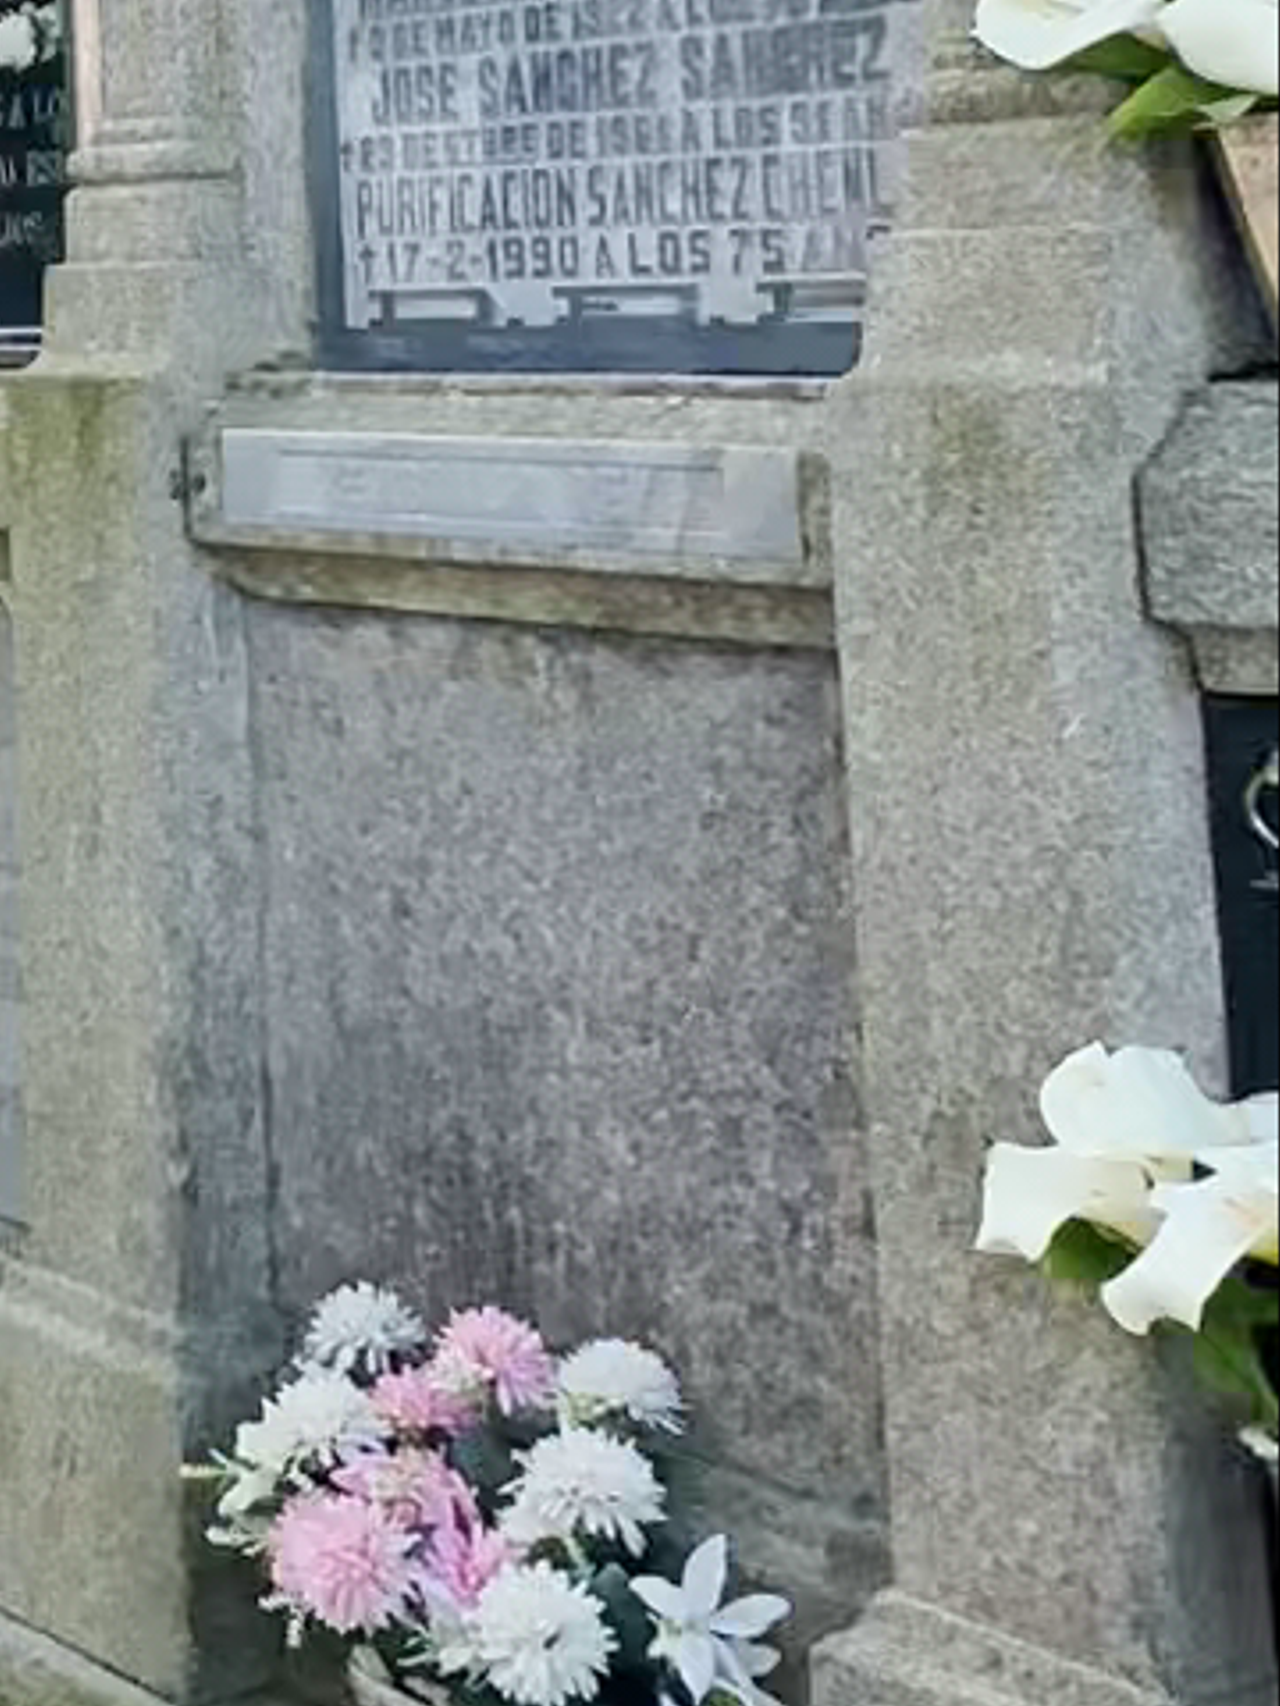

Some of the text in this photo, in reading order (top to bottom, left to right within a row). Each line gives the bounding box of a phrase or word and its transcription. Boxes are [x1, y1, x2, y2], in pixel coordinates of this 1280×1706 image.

[436, 8, 517, 56] MAYO
[523, 0, 565, 43] DE
[372, 61, 459, 126] JOSE
[479, 39, 657, 119] SANCHEZ
[545, 118, 587, 161] DE
[681, 109, 702, 153] A
[710, 105, 783, 150] LOS
[357, 147, 884, 239] PURIFICACION SANCHEZ CHENL
[386, 235, 580, 284] 17-2-1990
[594, 231, 616, 278] A
[627, 228, 711, 277] LOS
[728, 227, 786, 276] 75
